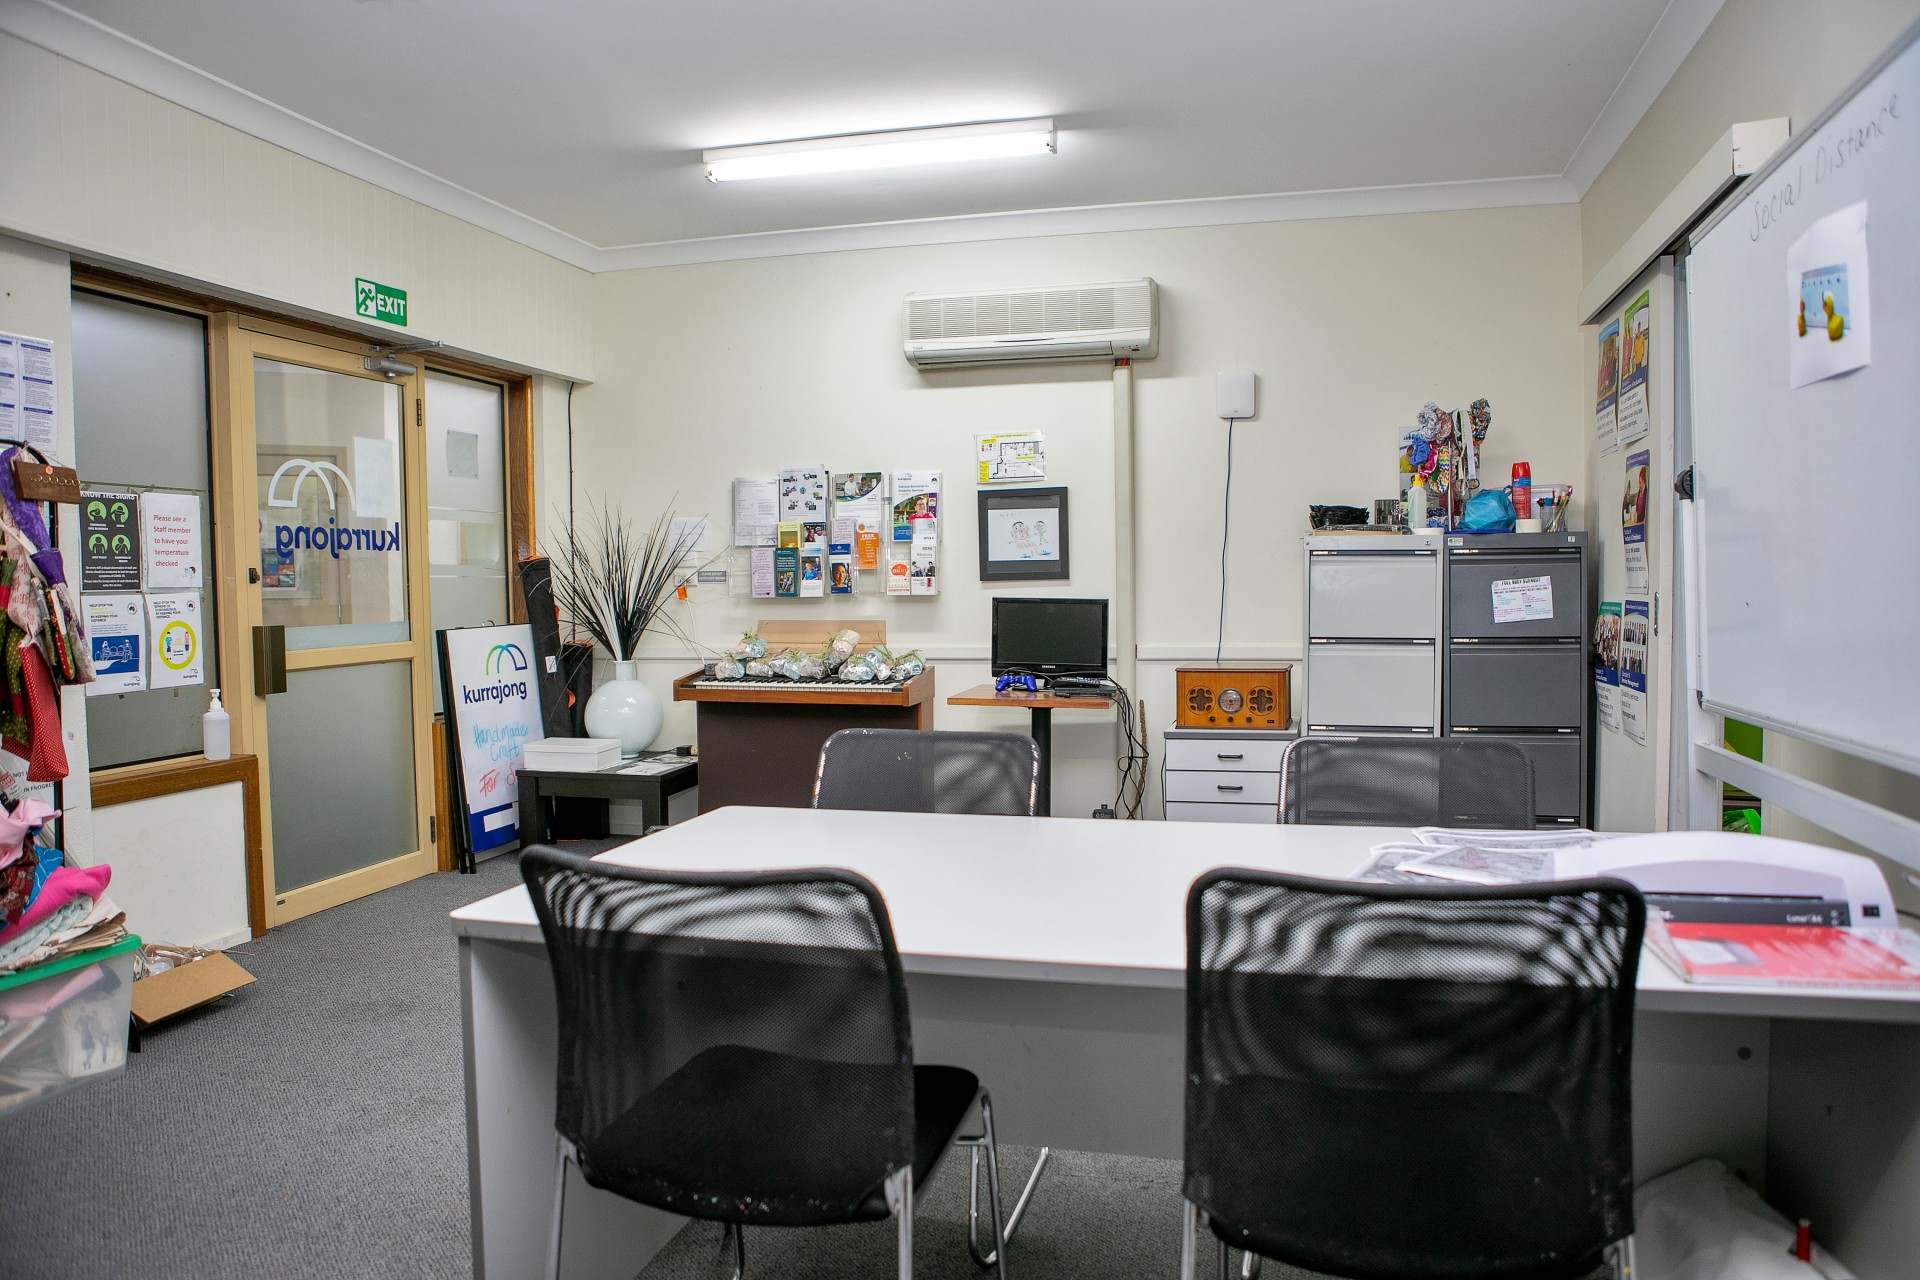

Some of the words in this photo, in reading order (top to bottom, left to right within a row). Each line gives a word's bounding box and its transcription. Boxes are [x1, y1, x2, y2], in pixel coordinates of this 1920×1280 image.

[1750, 165, 1802, 242] Social
[1815, 93, 1901, 184] Distance
[377, 293, 406, 317] EXIT
[153, 514, 172, 522] Please
[172, 515, 182, 523] see
[153, 525, 167, 533] Staff
[167, 526, 192, 534] member
[161, 537, 175, 545] have
[175, 538, 189, 546] your
[154, 549, 190, 557] temperature
[463, 679, 528, 704] kurrajong
[479, 768, 500, 798] For
